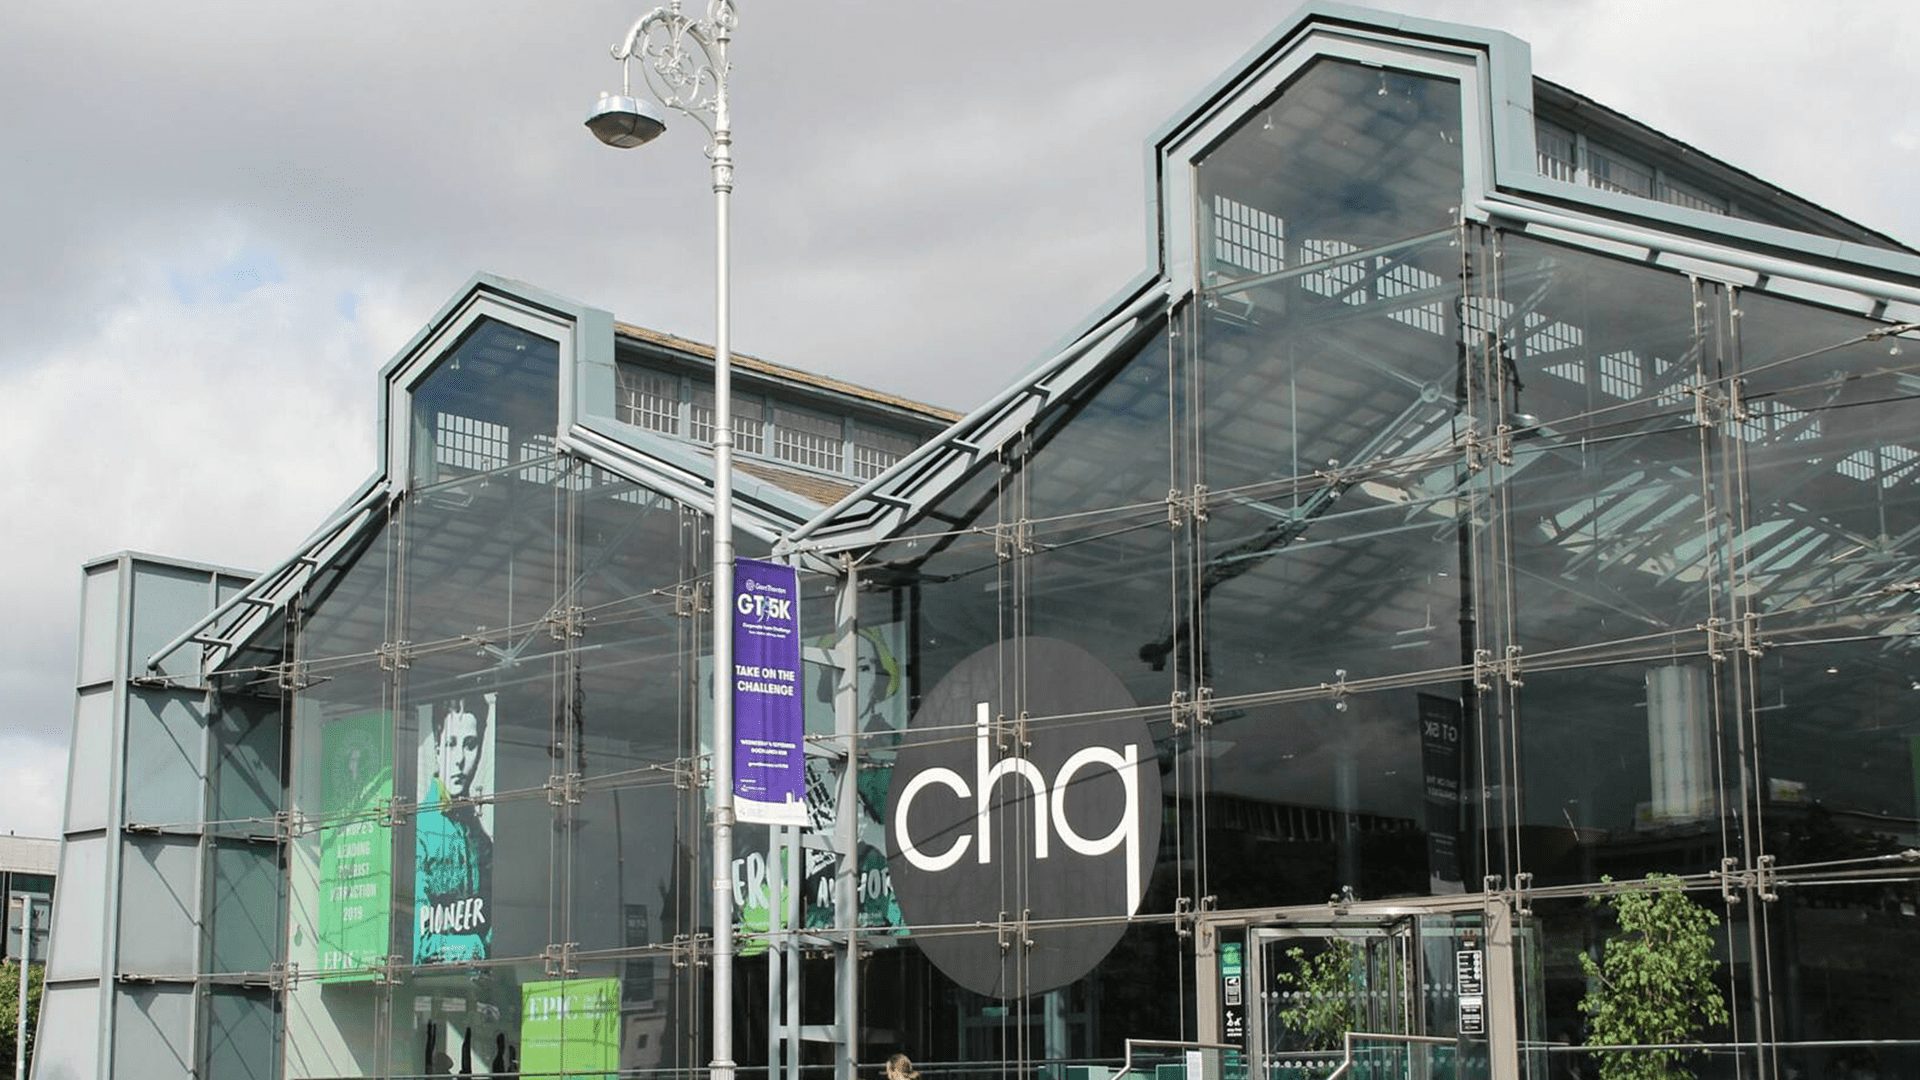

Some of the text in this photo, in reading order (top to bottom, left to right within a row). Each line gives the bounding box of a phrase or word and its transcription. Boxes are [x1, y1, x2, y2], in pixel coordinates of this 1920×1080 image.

[738, 593, 791, 620] GT 5K
[736, 665, 795, 681] TAKE ON THE
[738, 681, 794, 696] CHALLENGE
[895, 702, 1140, 920] chq
[336, 840, 371, 859] LEADING
[343, 905, 364, 922] 2019
[420, 898, 486, 936] PIONEER
[529, 994, 579, 1021] EPIC
